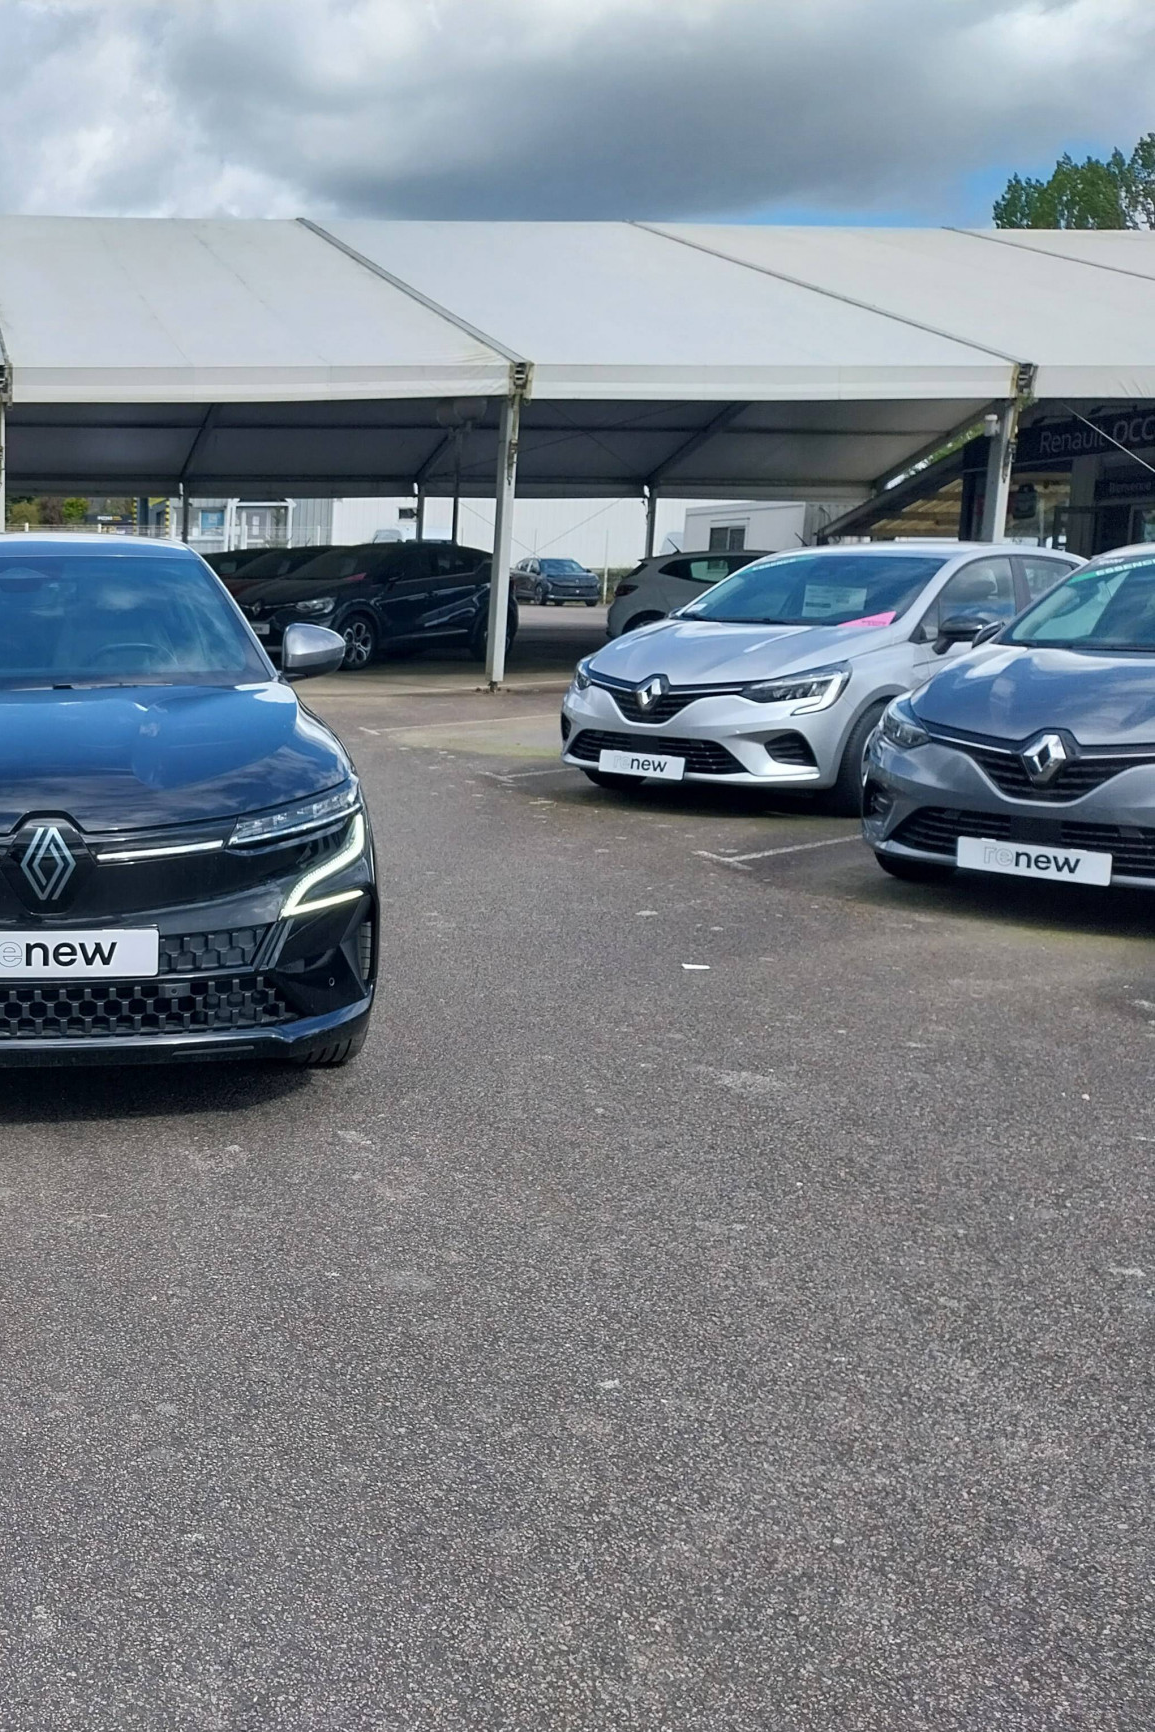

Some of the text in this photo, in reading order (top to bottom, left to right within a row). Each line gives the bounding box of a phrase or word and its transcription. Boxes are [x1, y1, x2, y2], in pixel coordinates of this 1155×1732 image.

[1039, 424, 1106, 453] Renault
[1095, 558, 1155, 576] ESSENC
[613, 755, 667, 772] renew
[983, 846, 1081, 874] renew
